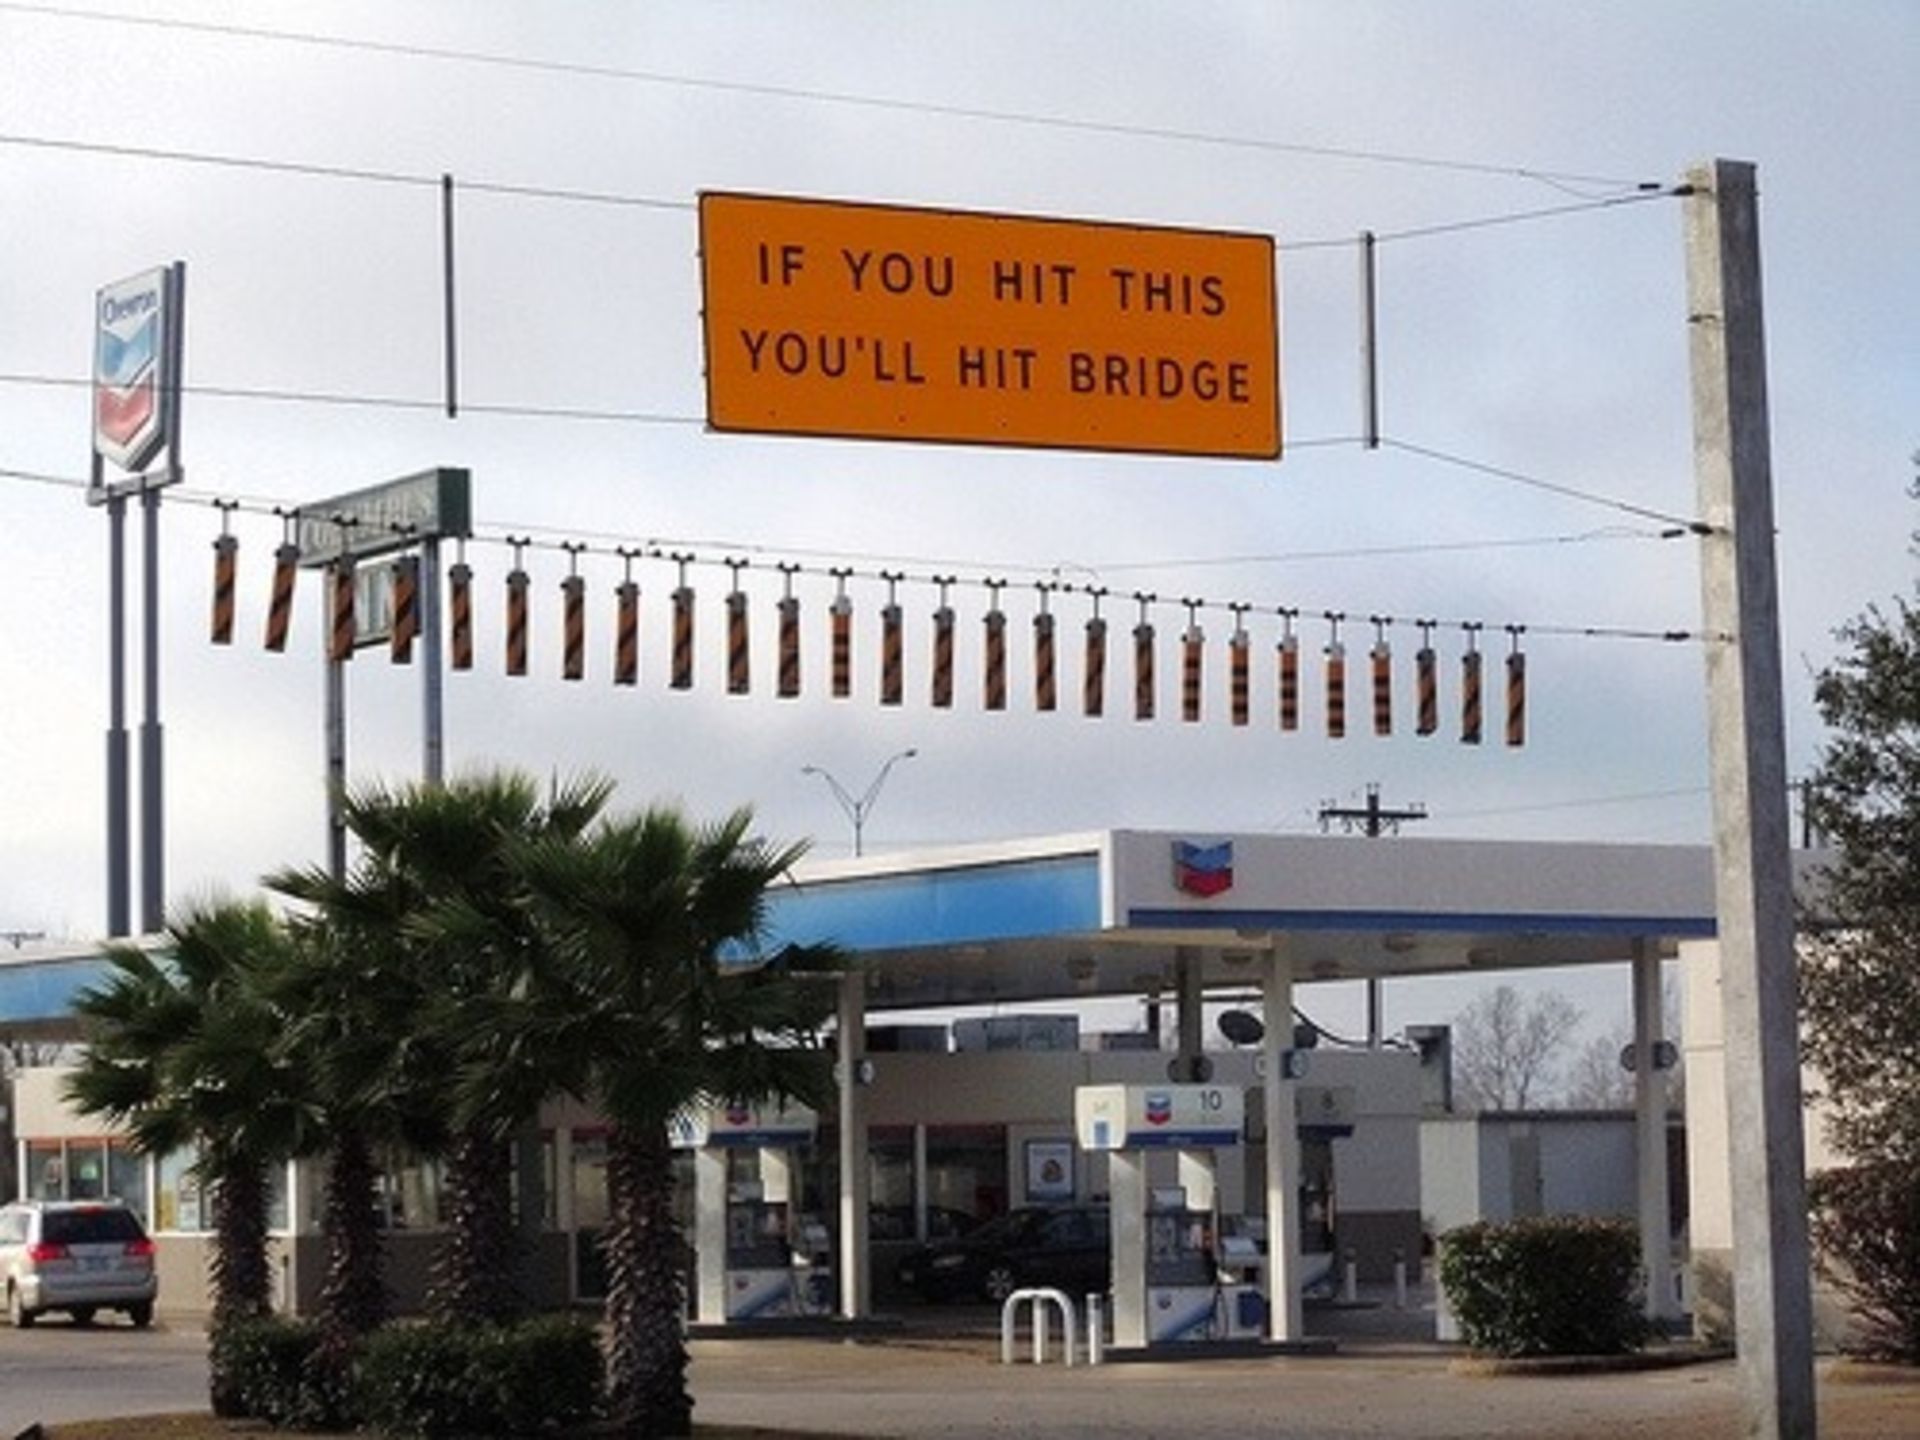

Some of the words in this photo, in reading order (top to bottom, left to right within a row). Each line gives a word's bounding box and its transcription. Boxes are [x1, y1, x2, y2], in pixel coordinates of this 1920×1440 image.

[758, 243, 805, 286] IF
[842, 248, 954, 298] YOU
[993, 260, 1077, 305] HIT
[1110, 268, 1226, 317] THIS
[739, 328, 926, 385] YOU'LL
[958, 345, 1038, 391] HIT
[1069, 351, 1250, 404] BRIDGE
[1201, 1089, 1222, 1111] 10
